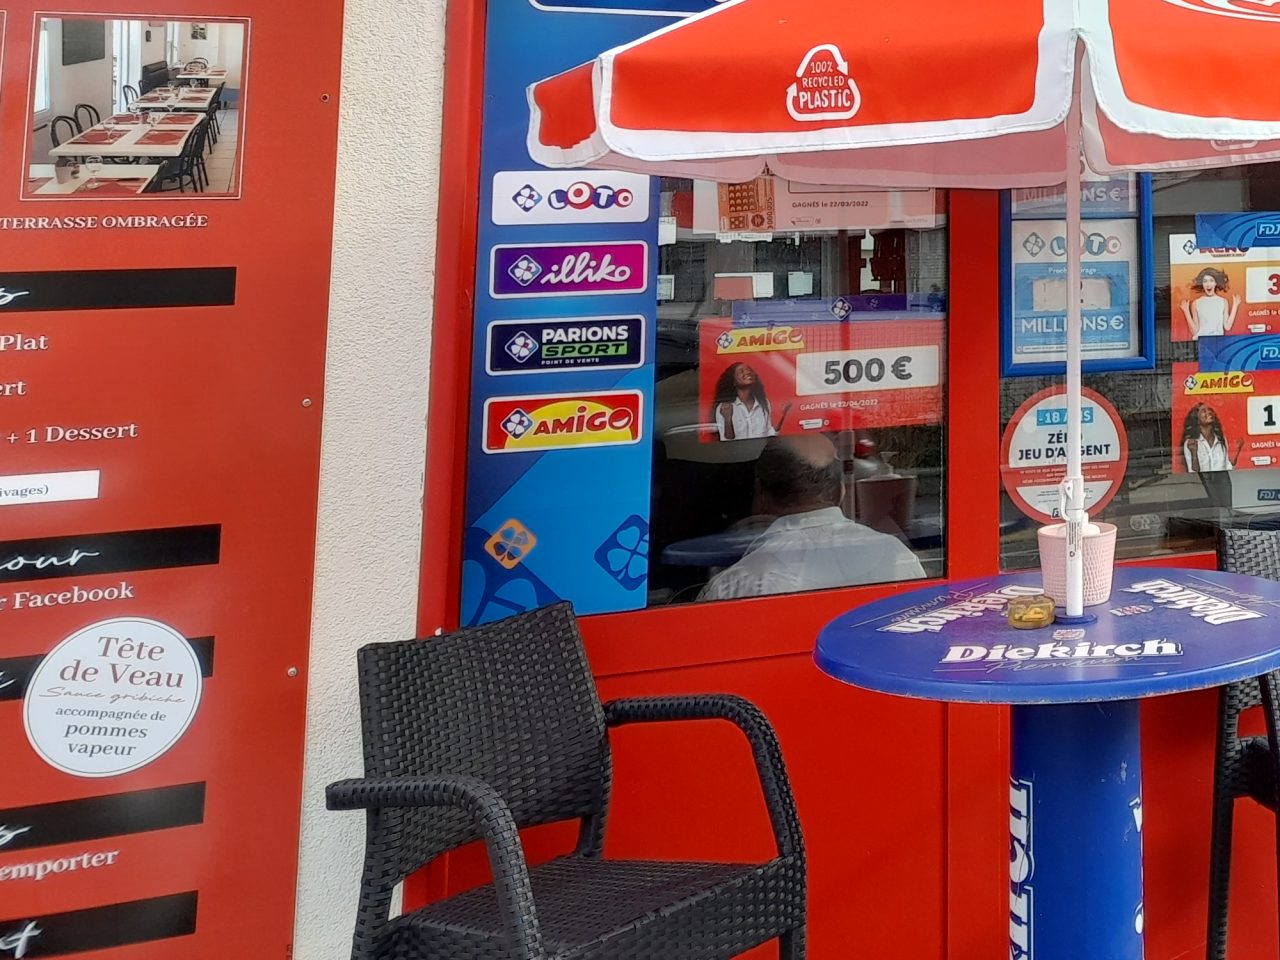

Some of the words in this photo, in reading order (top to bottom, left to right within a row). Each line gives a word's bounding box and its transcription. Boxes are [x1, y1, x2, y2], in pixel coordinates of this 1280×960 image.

[810, 61, 833, 74] 100%
[802, 76, 845, 88] RECYCLED
[548, 181, 634, 210] LOTO
[0, 215, 97, 229] TERRASSE
[102, 212, 208, 228] OMBRAGÉE
[1258, 223, 1280, 235] FDJ
[1051, 231, 1121, 256] LTO
[541, 251, 631, 284] illiko
[1022, 315, 1107, 333] MILLINS
[542, 325, 629, 342] PARIONS
[0, 334, 48, 351] Plat
[544, 343, 627, 357] SPORT
[824, 358, 885, 385] 500
[891, 356, 913, 380] €
[1200, 372, 1253, 389] AMIGO
[533, 406, 633, 436] AMIGO
[26, 429, 38, 443] 1
[46, 424, 138, 442] Dessert
[1018, 448, 1041, 460] JEU
[1045, 444, 1111, 458] D'AGENT
[13, 582, 134, 609] Facebook
[98, 637, 165, 661] Tête
[939, 637, 1184, 663] Diekirch
[59, 659, 98, 682] de
[109, 663, 184, 688] Veau
[55, 707, 147, 721] accompagnée
[150, 710, 167, 721] de
[64, 724, 148, 739] pommes
[68, 742, 136, 758] vapeur
[0, 850, 120, 880] emporter
